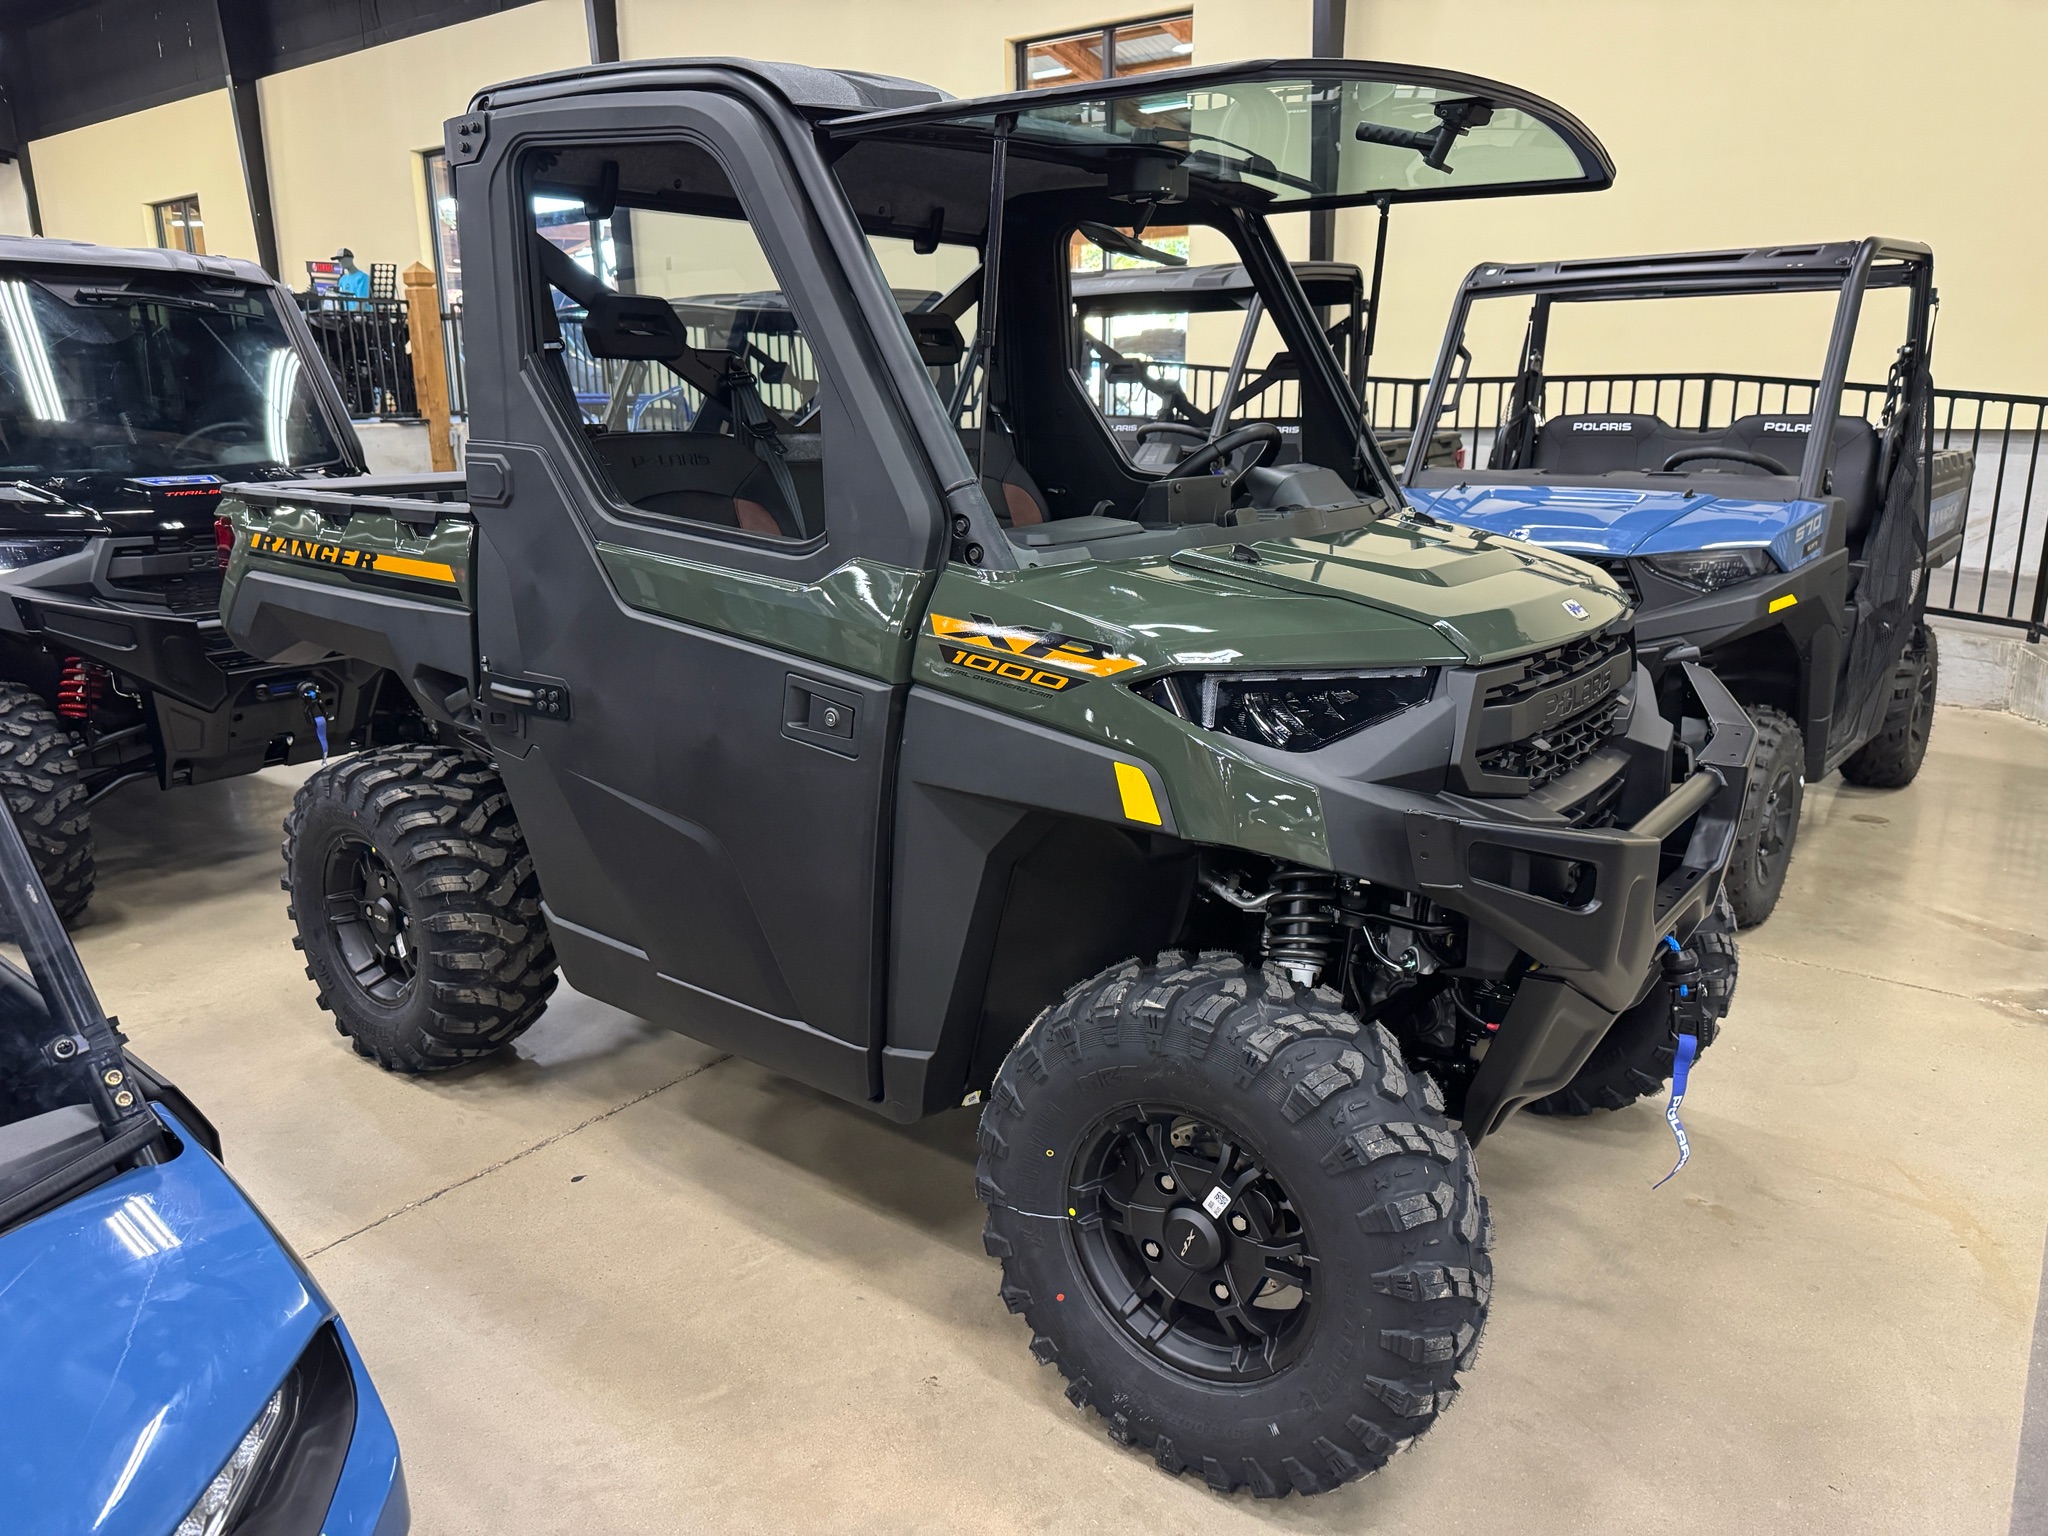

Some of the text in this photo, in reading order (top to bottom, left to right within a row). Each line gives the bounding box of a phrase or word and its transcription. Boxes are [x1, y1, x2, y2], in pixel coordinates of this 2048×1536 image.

[1111, 424, 1138, 432] LARIS
[1275, 425, 1300, 434] ARIS
[1573, 422, 1632, 431] POLARIS
[1763, 422, 1812, 433] POLAR
[1795, 513, 1823, 544] 570
[257, 532, 378, 571] RANGER
[938, 611, 1116, 661] XP
[944, 667, 1055, 700] DUAL OVERHEAD CAM
[951, 649, 1069, 691] 1000
[1543, 669, 1612, 724] POLARIS
